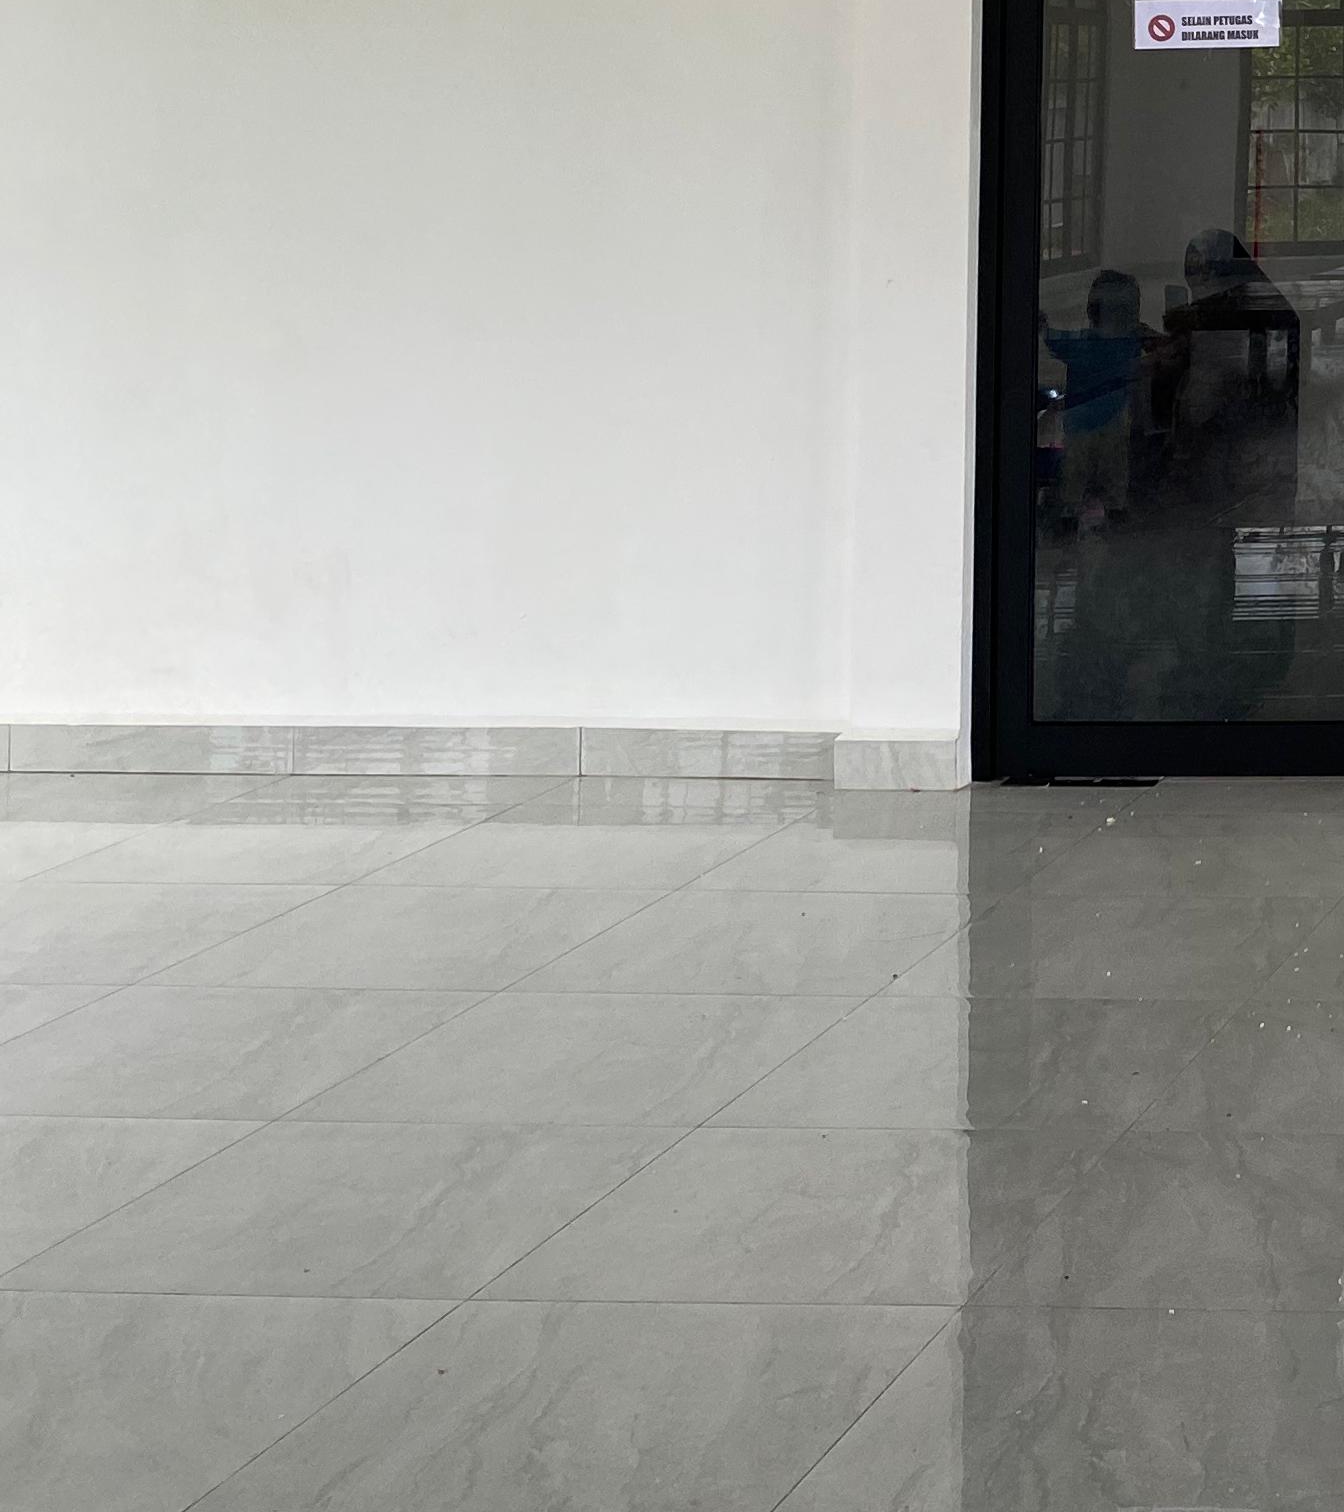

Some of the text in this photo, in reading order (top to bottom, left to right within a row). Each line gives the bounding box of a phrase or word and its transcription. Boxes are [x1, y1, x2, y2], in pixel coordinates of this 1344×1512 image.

[1181, 15, 1253, 26] SELAIN PETUGAS
[1181, 30, 1259, 41] DILARANG MASUK
